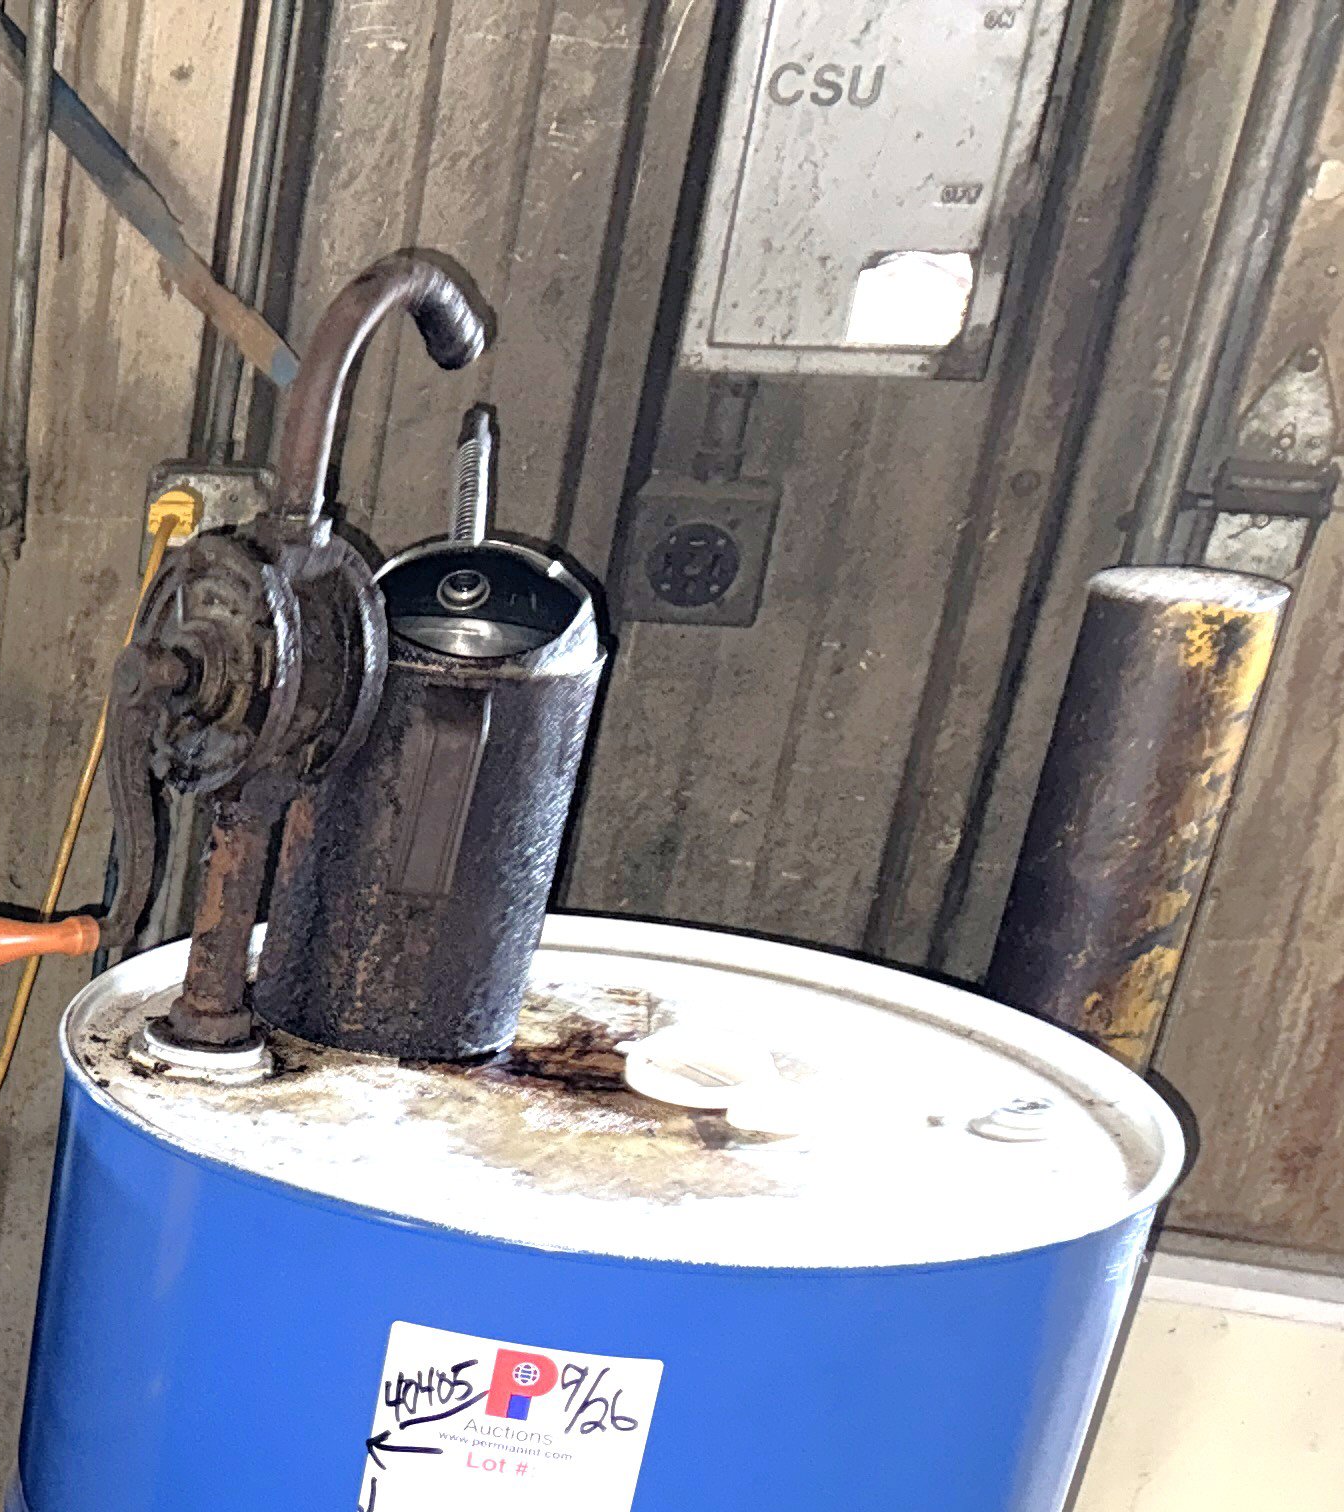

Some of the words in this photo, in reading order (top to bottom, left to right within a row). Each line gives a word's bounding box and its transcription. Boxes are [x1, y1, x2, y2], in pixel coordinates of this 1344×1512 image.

[768, 62, 886, 107] CSU
[463, 1418, 554, 1446] Auctions
[466, 1451, 507, 1474] Lot
